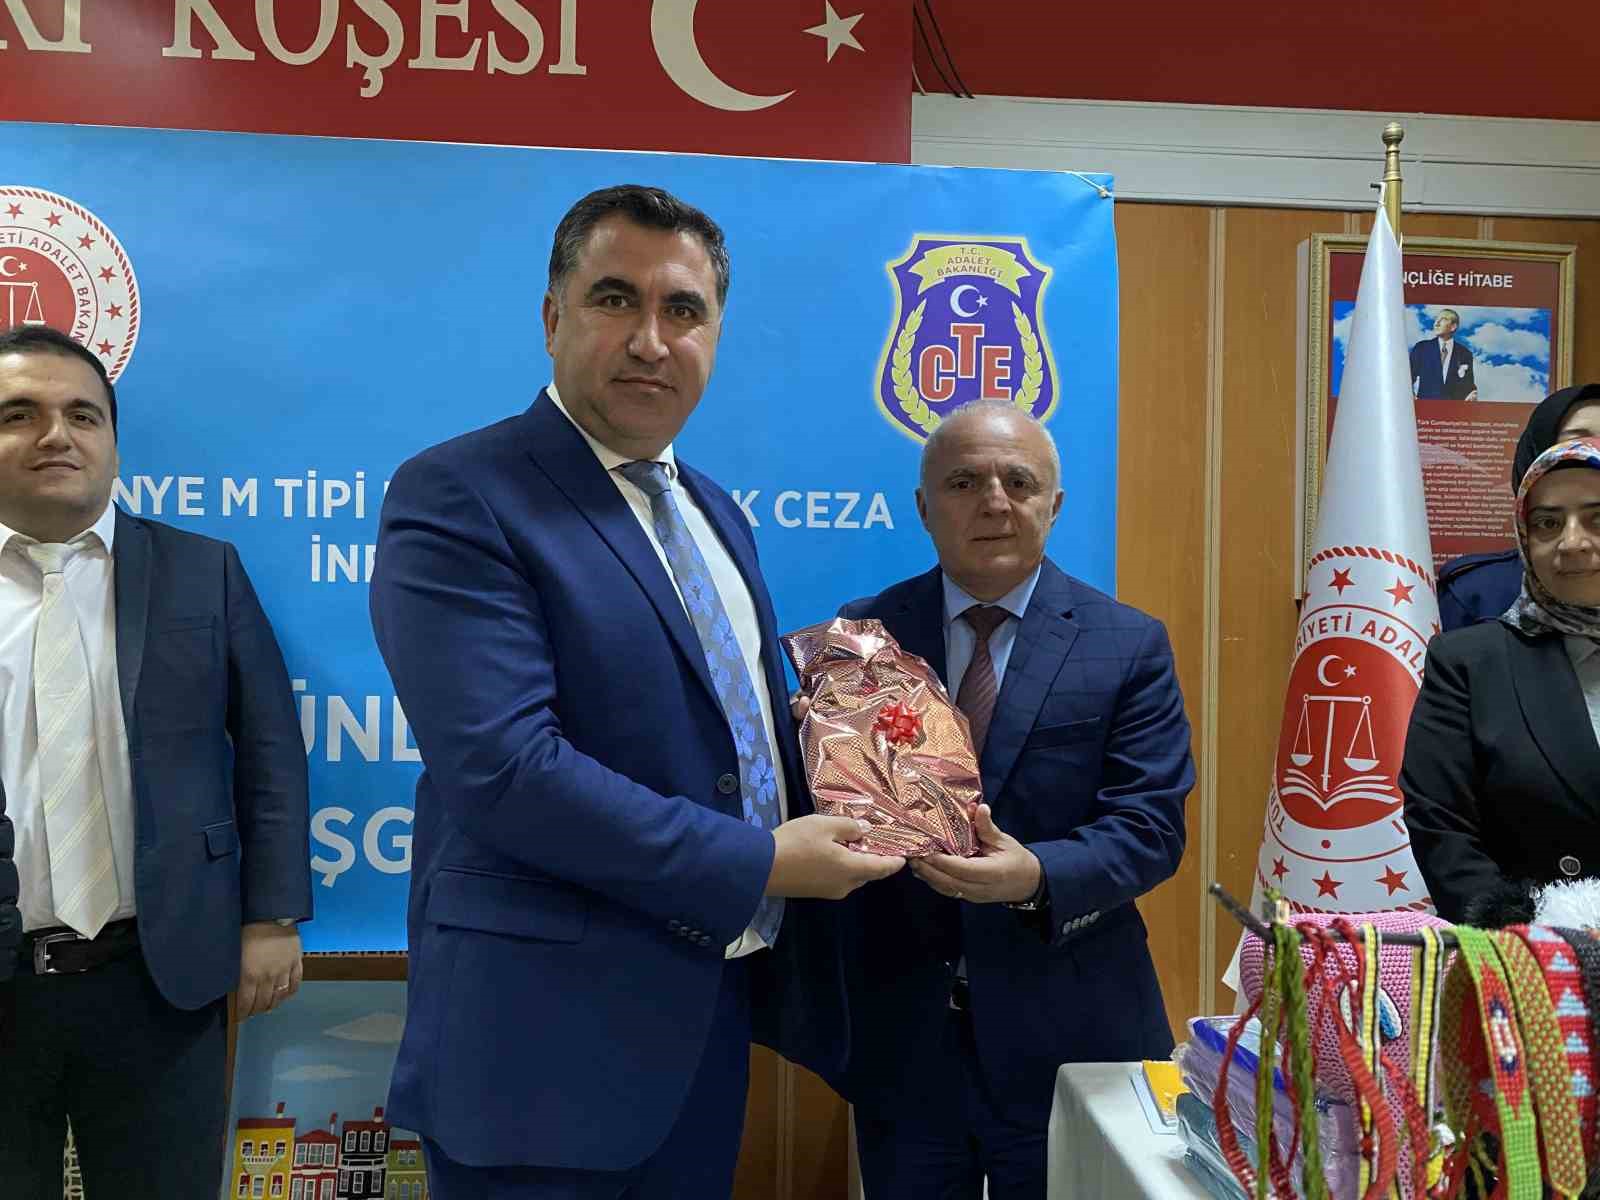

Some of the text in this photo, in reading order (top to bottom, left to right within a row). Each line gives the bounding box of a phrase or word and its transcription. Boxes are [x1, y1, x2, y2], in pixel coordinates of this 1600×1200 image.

[28, 236, 84, 281] ADALET
[1458, 271, 1513, 288] HİTABE
[221, 477, 258, 517] M
[274, 469, 365, 518] TİPİ
[774, 490, 895, 530] CEZA
[310, 806, 415, 889] ŞG
